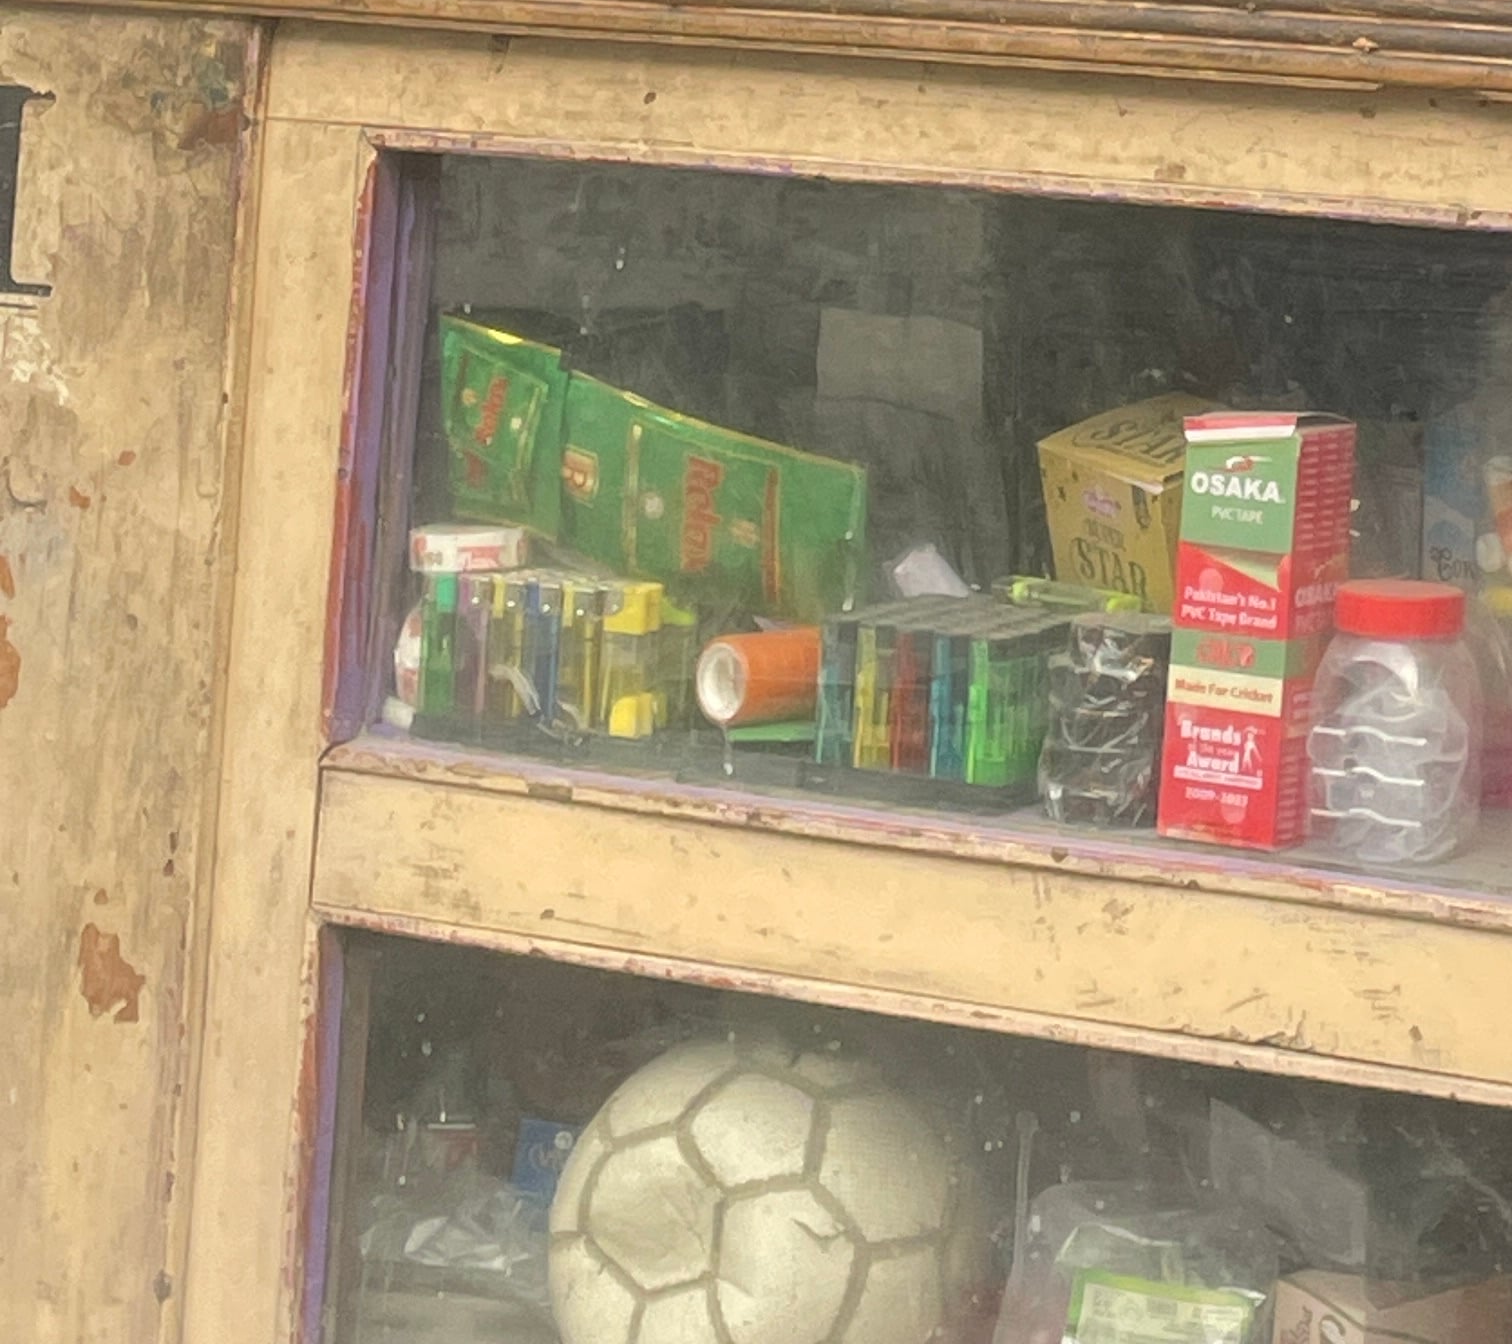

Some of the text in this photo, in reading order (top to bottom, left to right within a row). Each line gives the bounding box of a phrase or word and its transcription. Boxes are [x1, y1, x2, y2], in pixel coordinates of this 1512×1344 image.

[1190, 471, 1282, 504] OSAKA
[1211, 505, 1264, 524] PVC TAPE
[1184, 585, 1277, 611] Pakistan's No.1
[1181, 604, 1278, 630] PVC Tape Brand
[1175, 678, 1274, 704] Made For Cricket
[1180, 719, 1242, 746] Brands
[1186, 752, 1240, 774] Award
